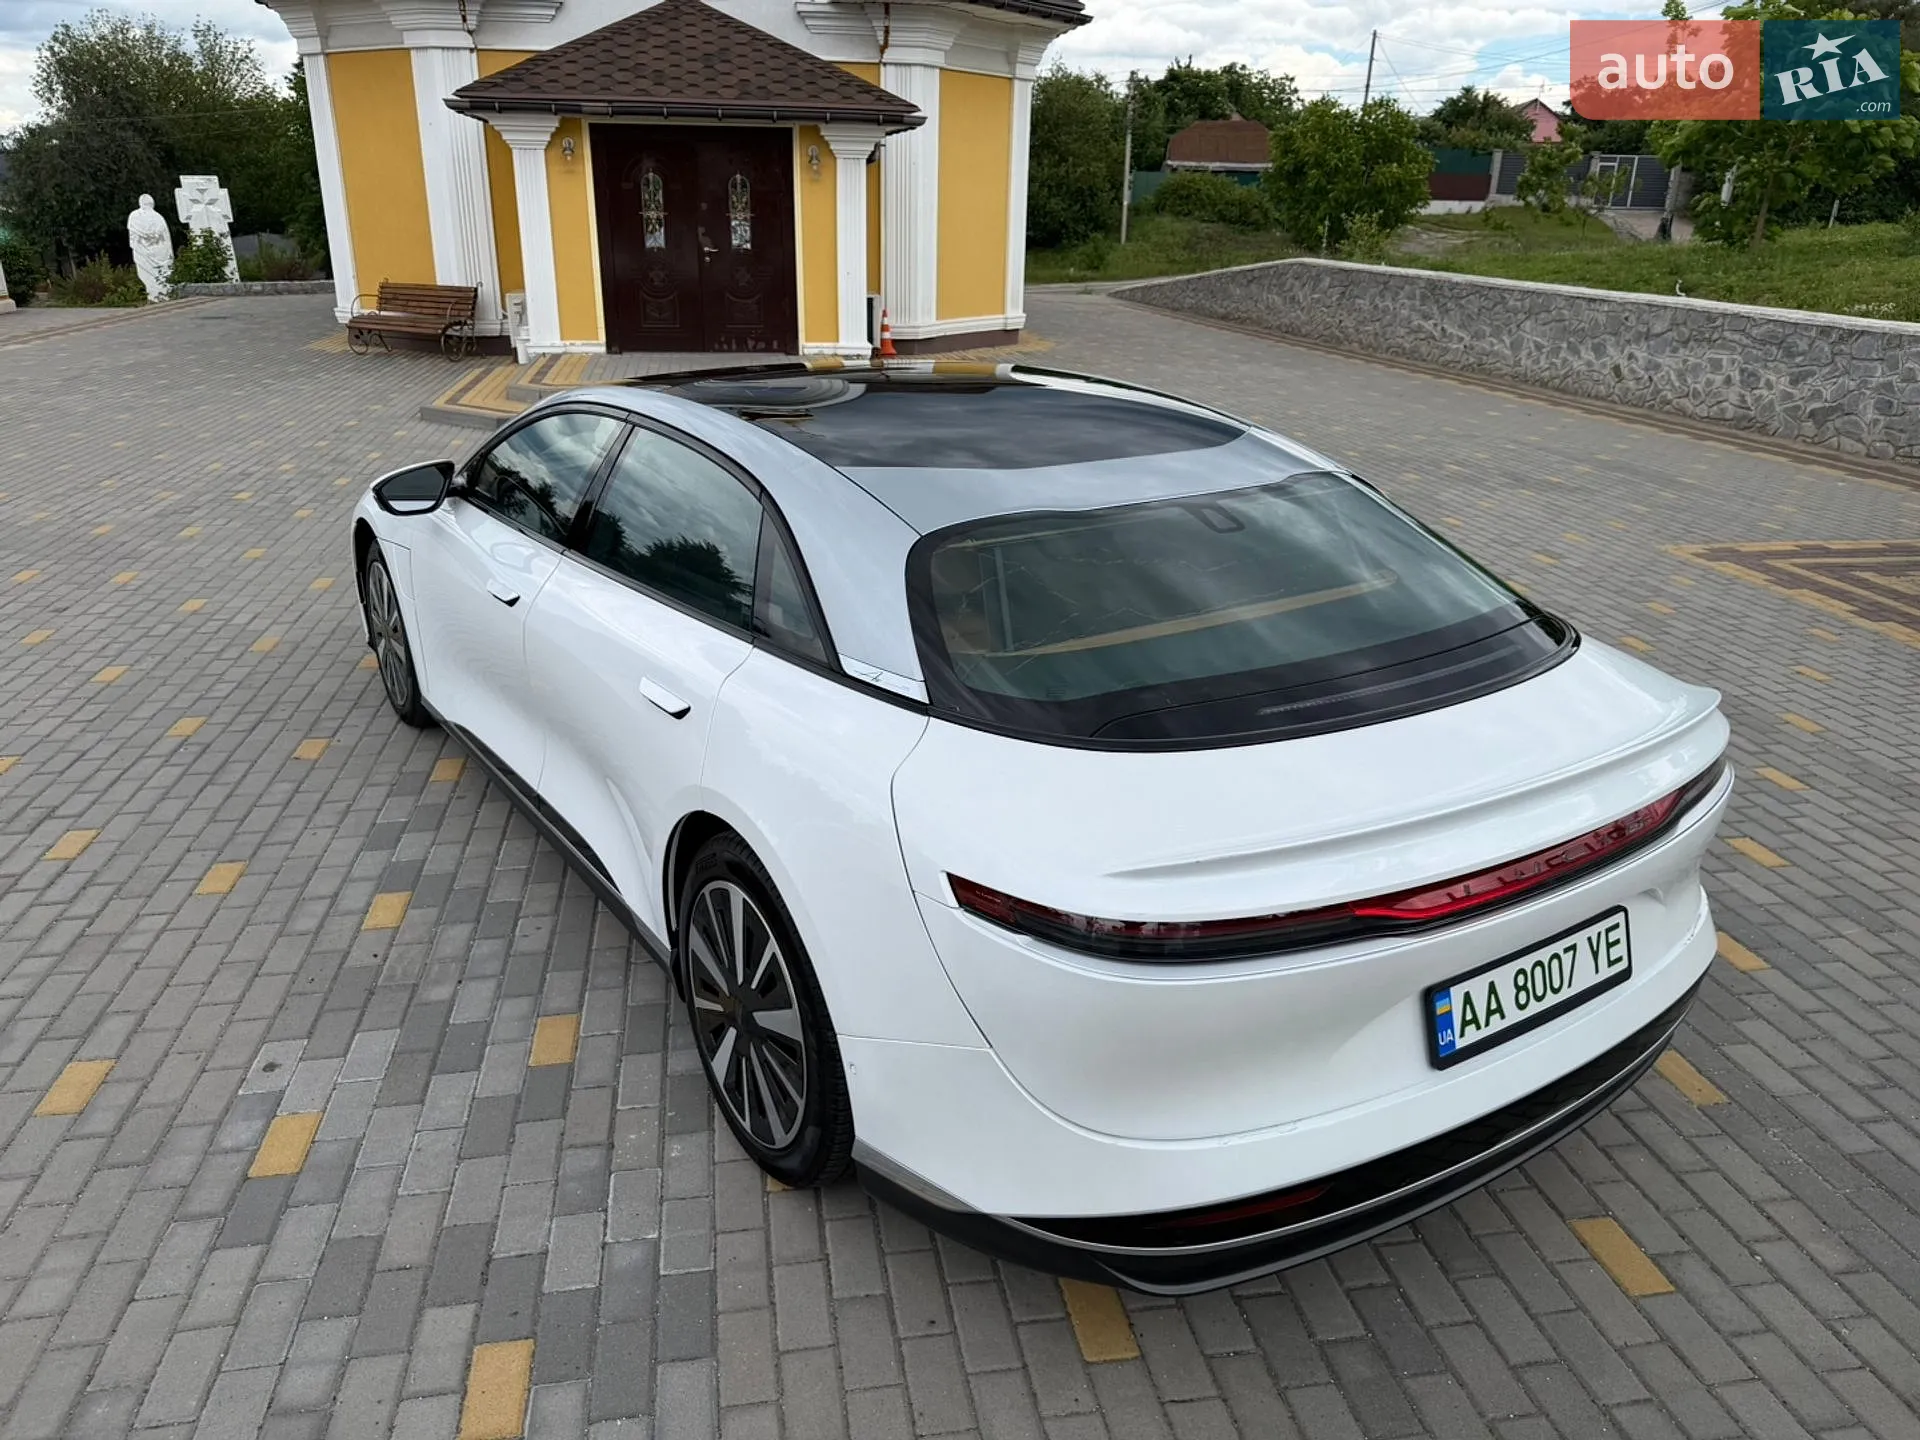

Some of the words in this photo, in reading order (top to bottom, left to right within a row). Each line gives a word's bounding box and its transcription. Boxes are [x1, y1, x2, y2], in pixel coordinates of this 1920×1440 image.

[1459, 980, 1506, 1038] AA
[1513, 943, 1577, 1011] 8007
[1587, 922, 1623, 975] YE
[1438, 1029, 1454, 1046] UA
